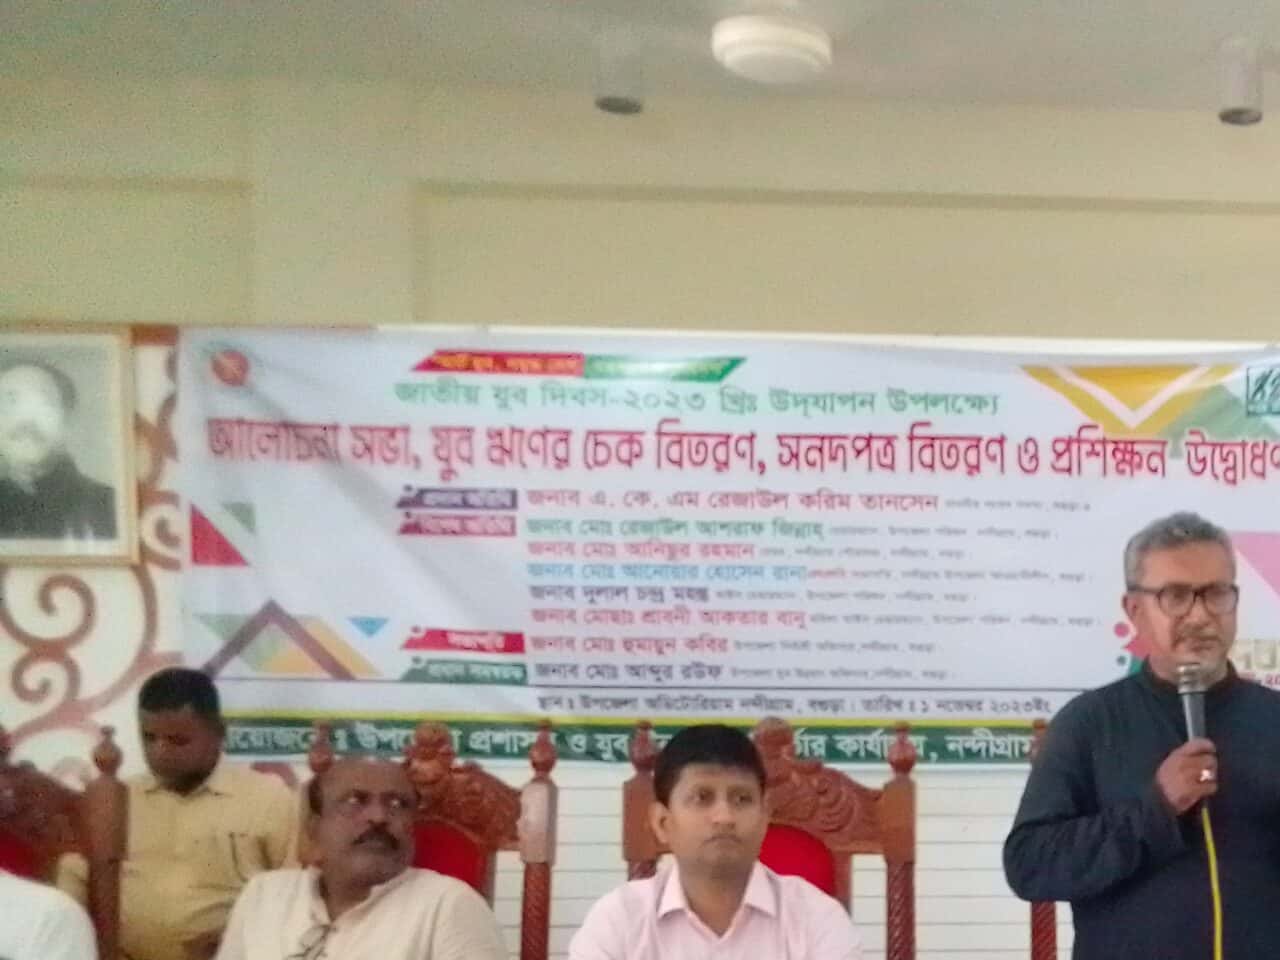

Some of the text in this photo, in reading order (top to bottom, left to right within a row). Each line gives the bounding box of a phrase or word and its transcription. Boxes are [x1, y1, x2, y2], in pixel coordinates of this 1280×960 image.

[493, 383, 528, 410] যুব
[208, 418, 342, 466] আলোচনা
[431, 426, 475, 481] যুব
[486, 426, 573, 470] ঋণের
[584, 430, 645, 470] চেক
[656, 418, 767, 475] বিতরণ,
[777, 432, 898, 474] সনদপত্র
[907, 421, 1007, 476] বিতরণ
[1017, 436, 1040, 475] ও
